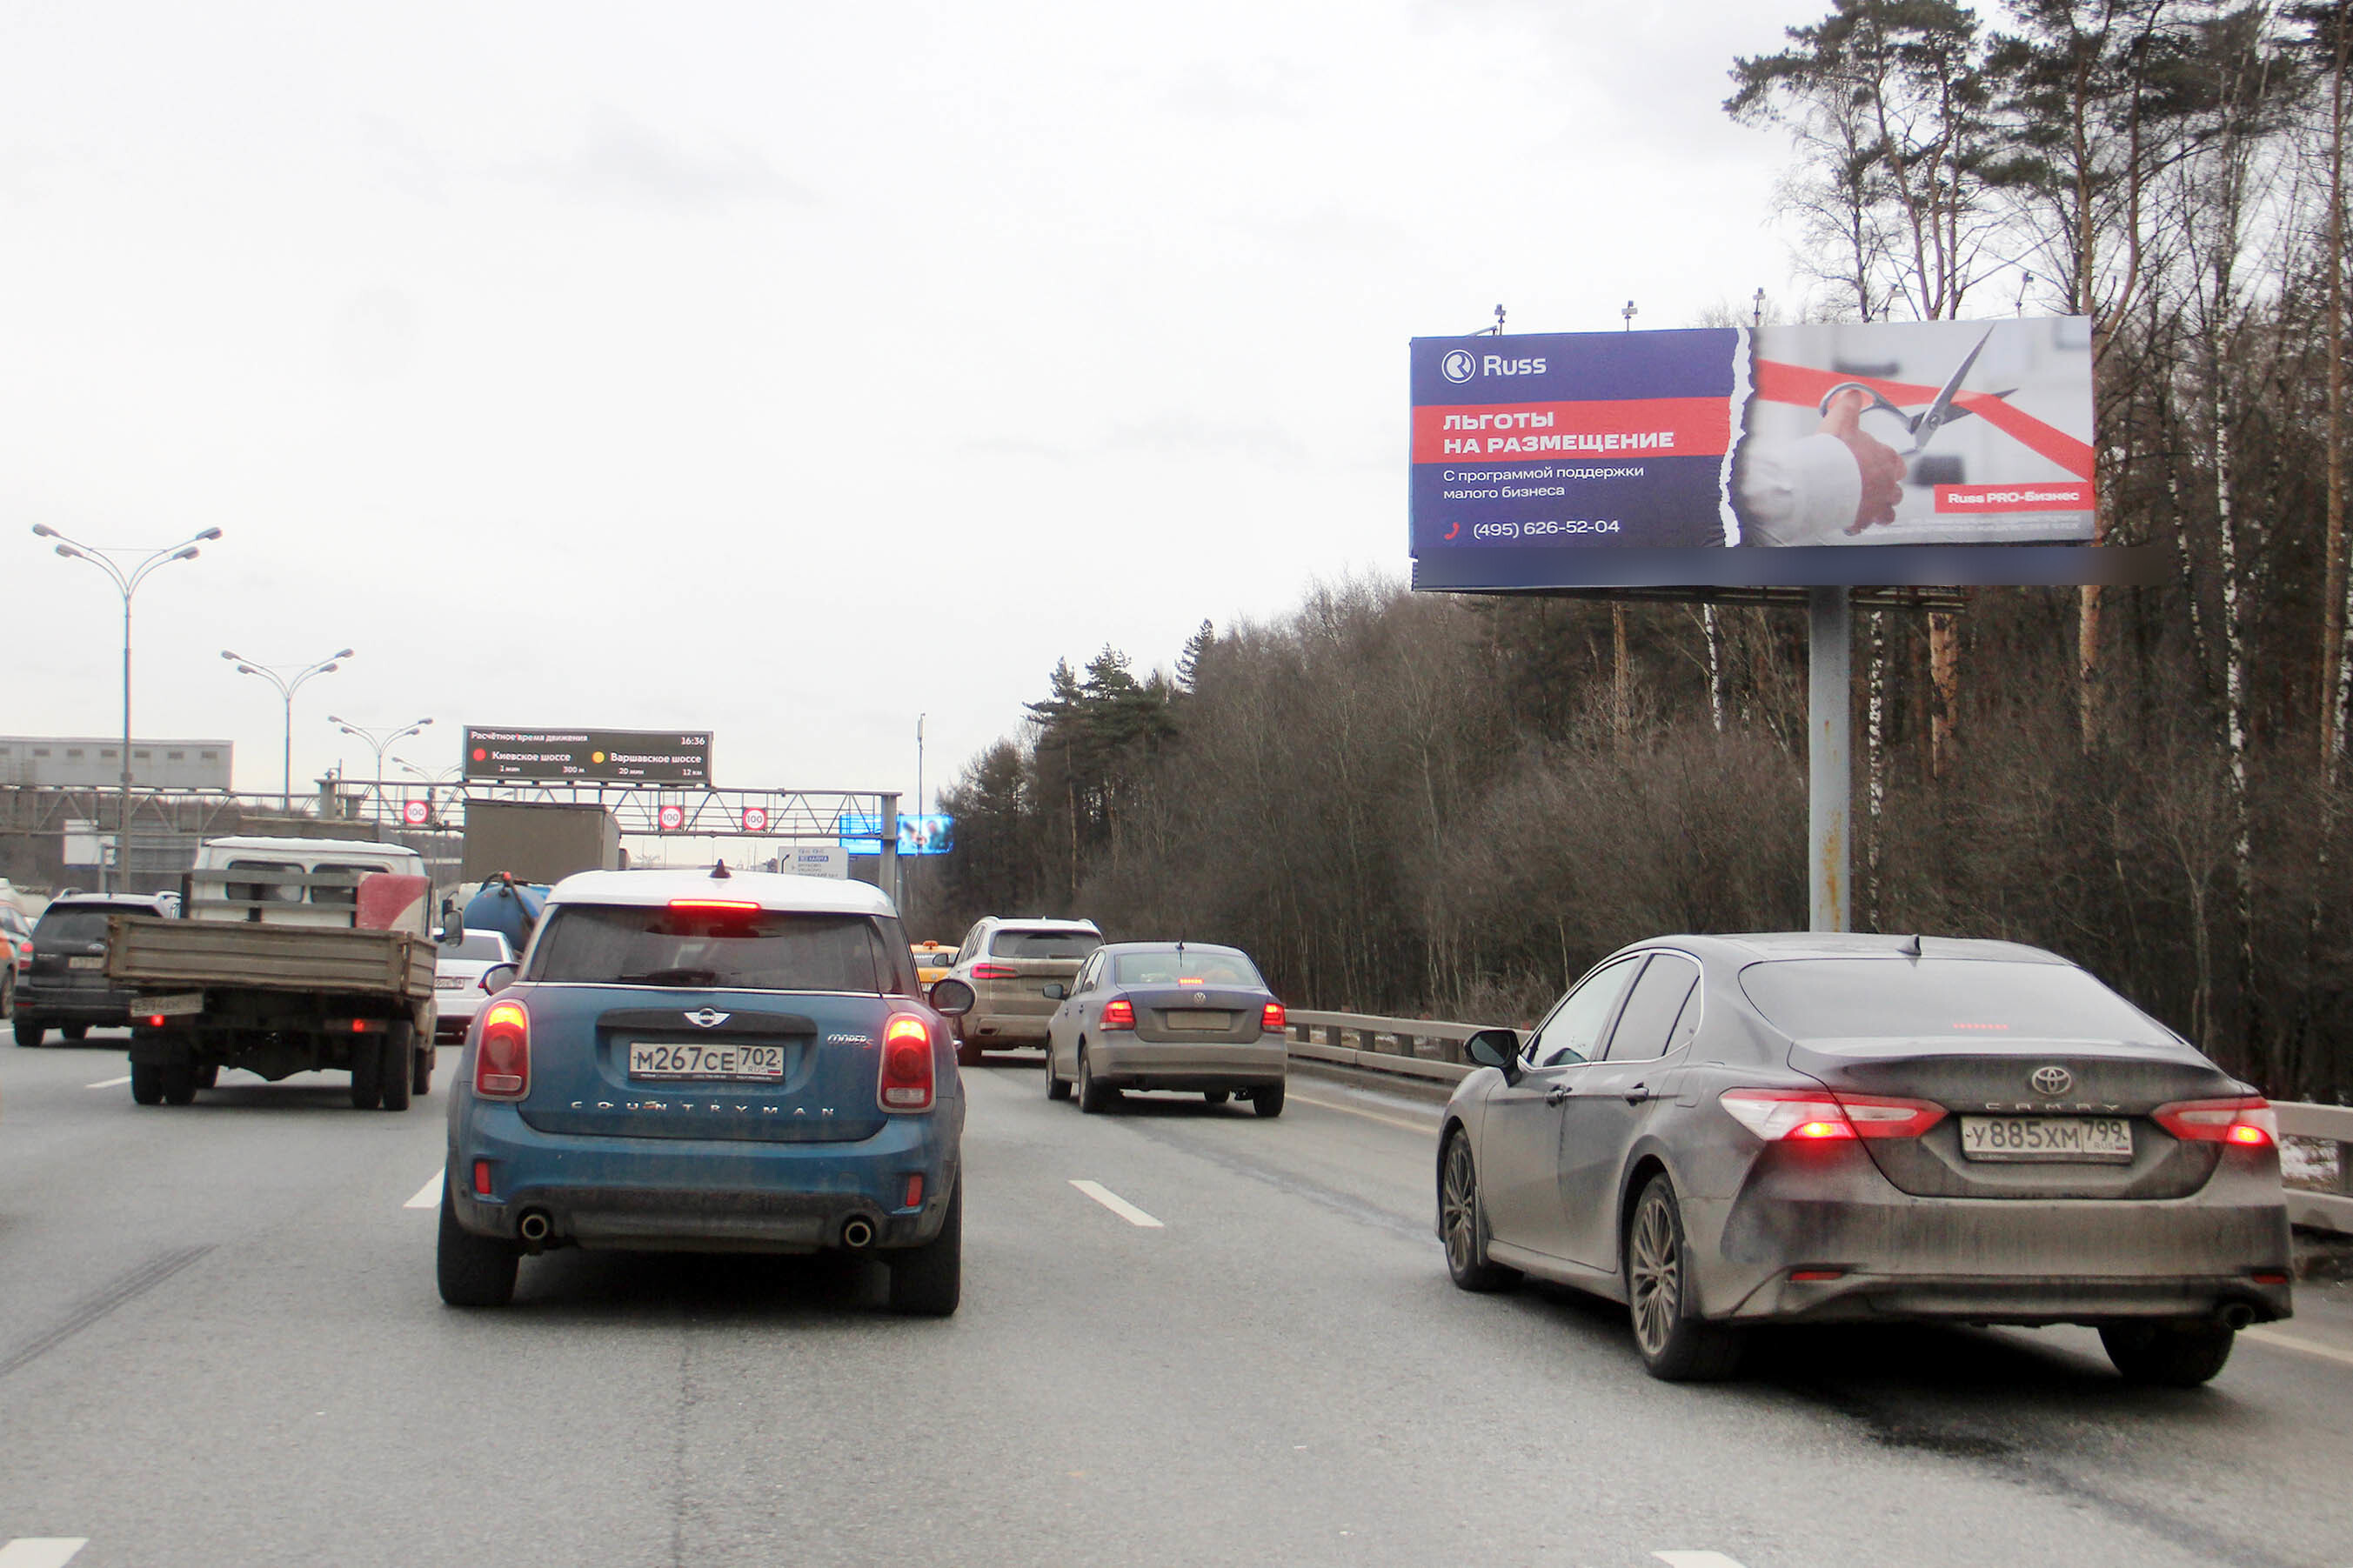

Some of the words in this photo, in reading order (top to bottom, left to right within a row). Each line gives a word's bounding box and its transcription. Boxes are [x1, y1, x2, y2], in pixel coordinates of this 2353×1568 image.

[1483, 355, 1547, 377] Russ
[1443, 411, 1554, 430] ЛЬГОТЫ
[1444, 438, 1481, 454] НА
[1487, 431, 1675, 453] РАЗМЕЩЕНИЕ
[1443, 470, 1455, 482] С
[1458, 466, 1553, 484] программой
[1556, 466, 1644, 482] поддержки
[1443, 489, 1499, 499] малого
[1501, 485, 1565, 497] бизнеса
[1948, 493, 1985, 504] Russ
[1986, 490, 2080, 504] PRO-Бизнес
[1474, 522, 1520, 540] (495)
[1523, 520, 1621, 535] 626-52-04
[516, 733, 545, 743] время
[680, 737, 705, 745] 16:36
[491, 751, 539, 762] Киевское
[540, 753, 572, 762] шоссе
[610, 752, 670, 764] Варшавское
[663, 813, 679, 822] 100
[747, 815, 764, 824] 100
[740, 1047, 778, 1066] 702
[571, 1101, 834, 1117] COUNTRYMAN
[2082, 1118, 2123, 1142] 799
